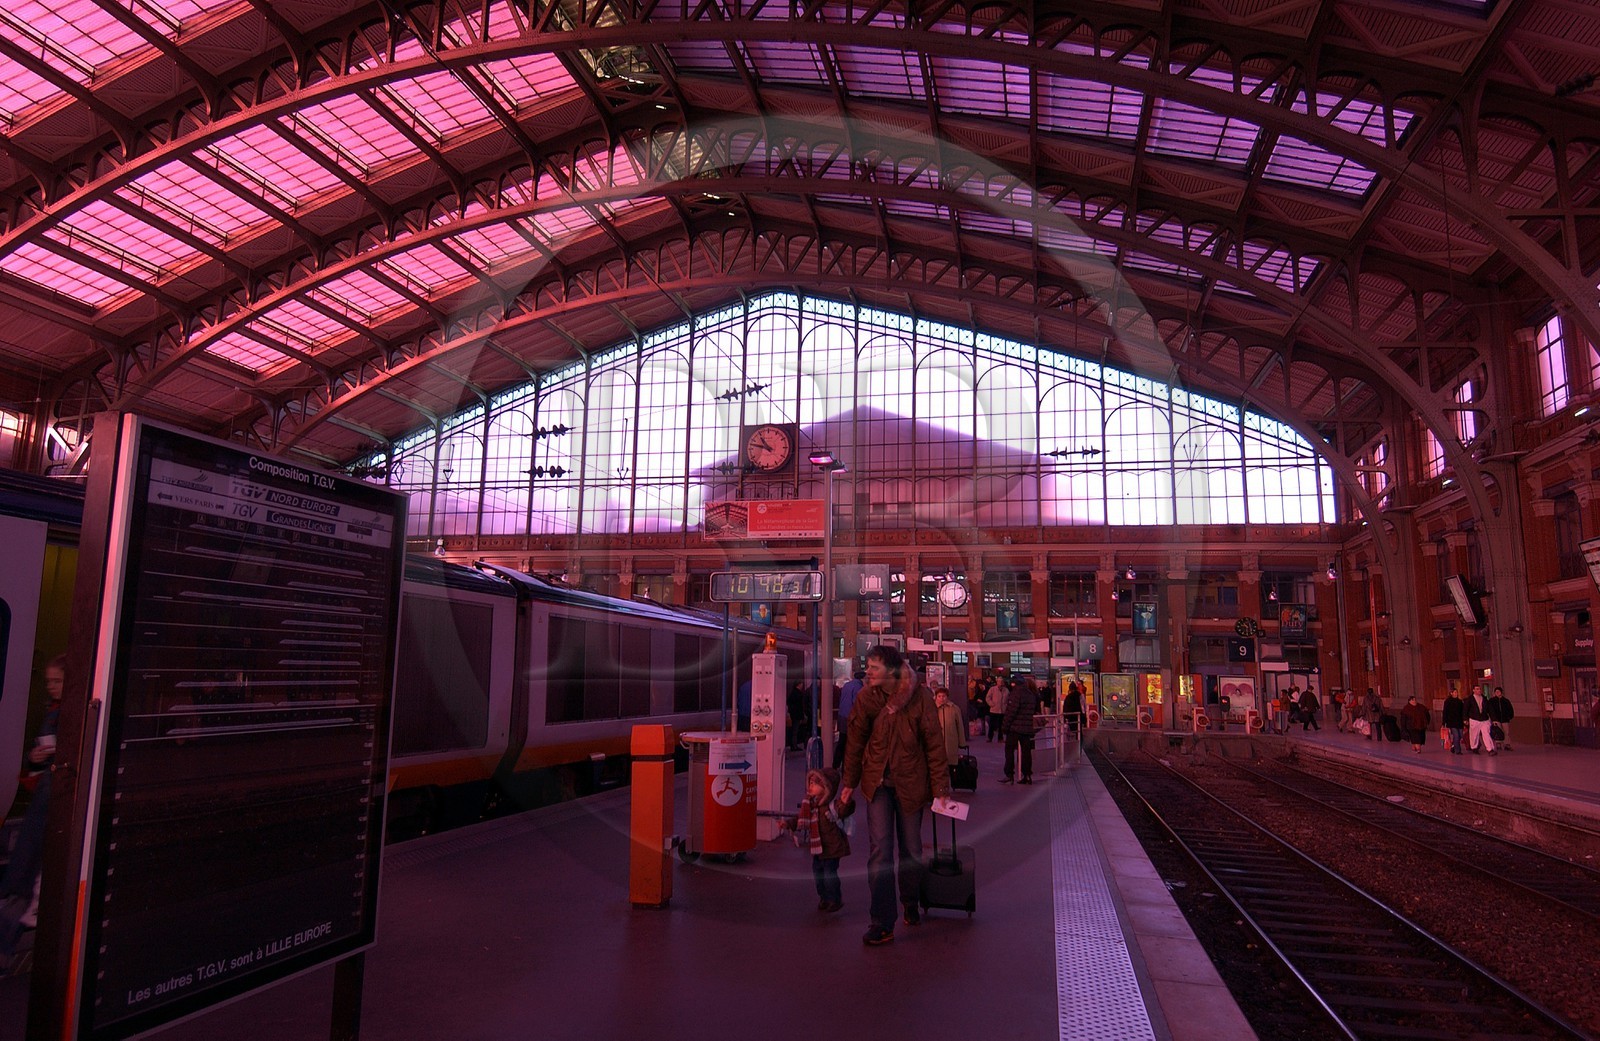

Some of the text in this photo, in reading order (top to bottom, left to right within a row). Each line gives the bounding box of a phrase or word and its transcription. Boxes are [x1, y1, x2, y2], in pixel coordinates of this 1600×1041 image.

[249, 456, 336, 490] Composition T.G.V.
[175, 495, 193, 505] VERS
[194, 500, 214, 509] PARIS
[232, 481, 266, 499] TGV
[270, 492, 299, 506] NORD
[300, 499, 337, 515] EUROPE
[232, 502, 258, 518] TGV
[731, 576, 748, 594] 10
[865, 641, 872, 651] 7
[1089, 643, 1097, 654] 8
[1239, 645, 1247, 656] 9
[127, 921, 332, 1005] Les autres T.G.V. sont à LILLE EUROPE
